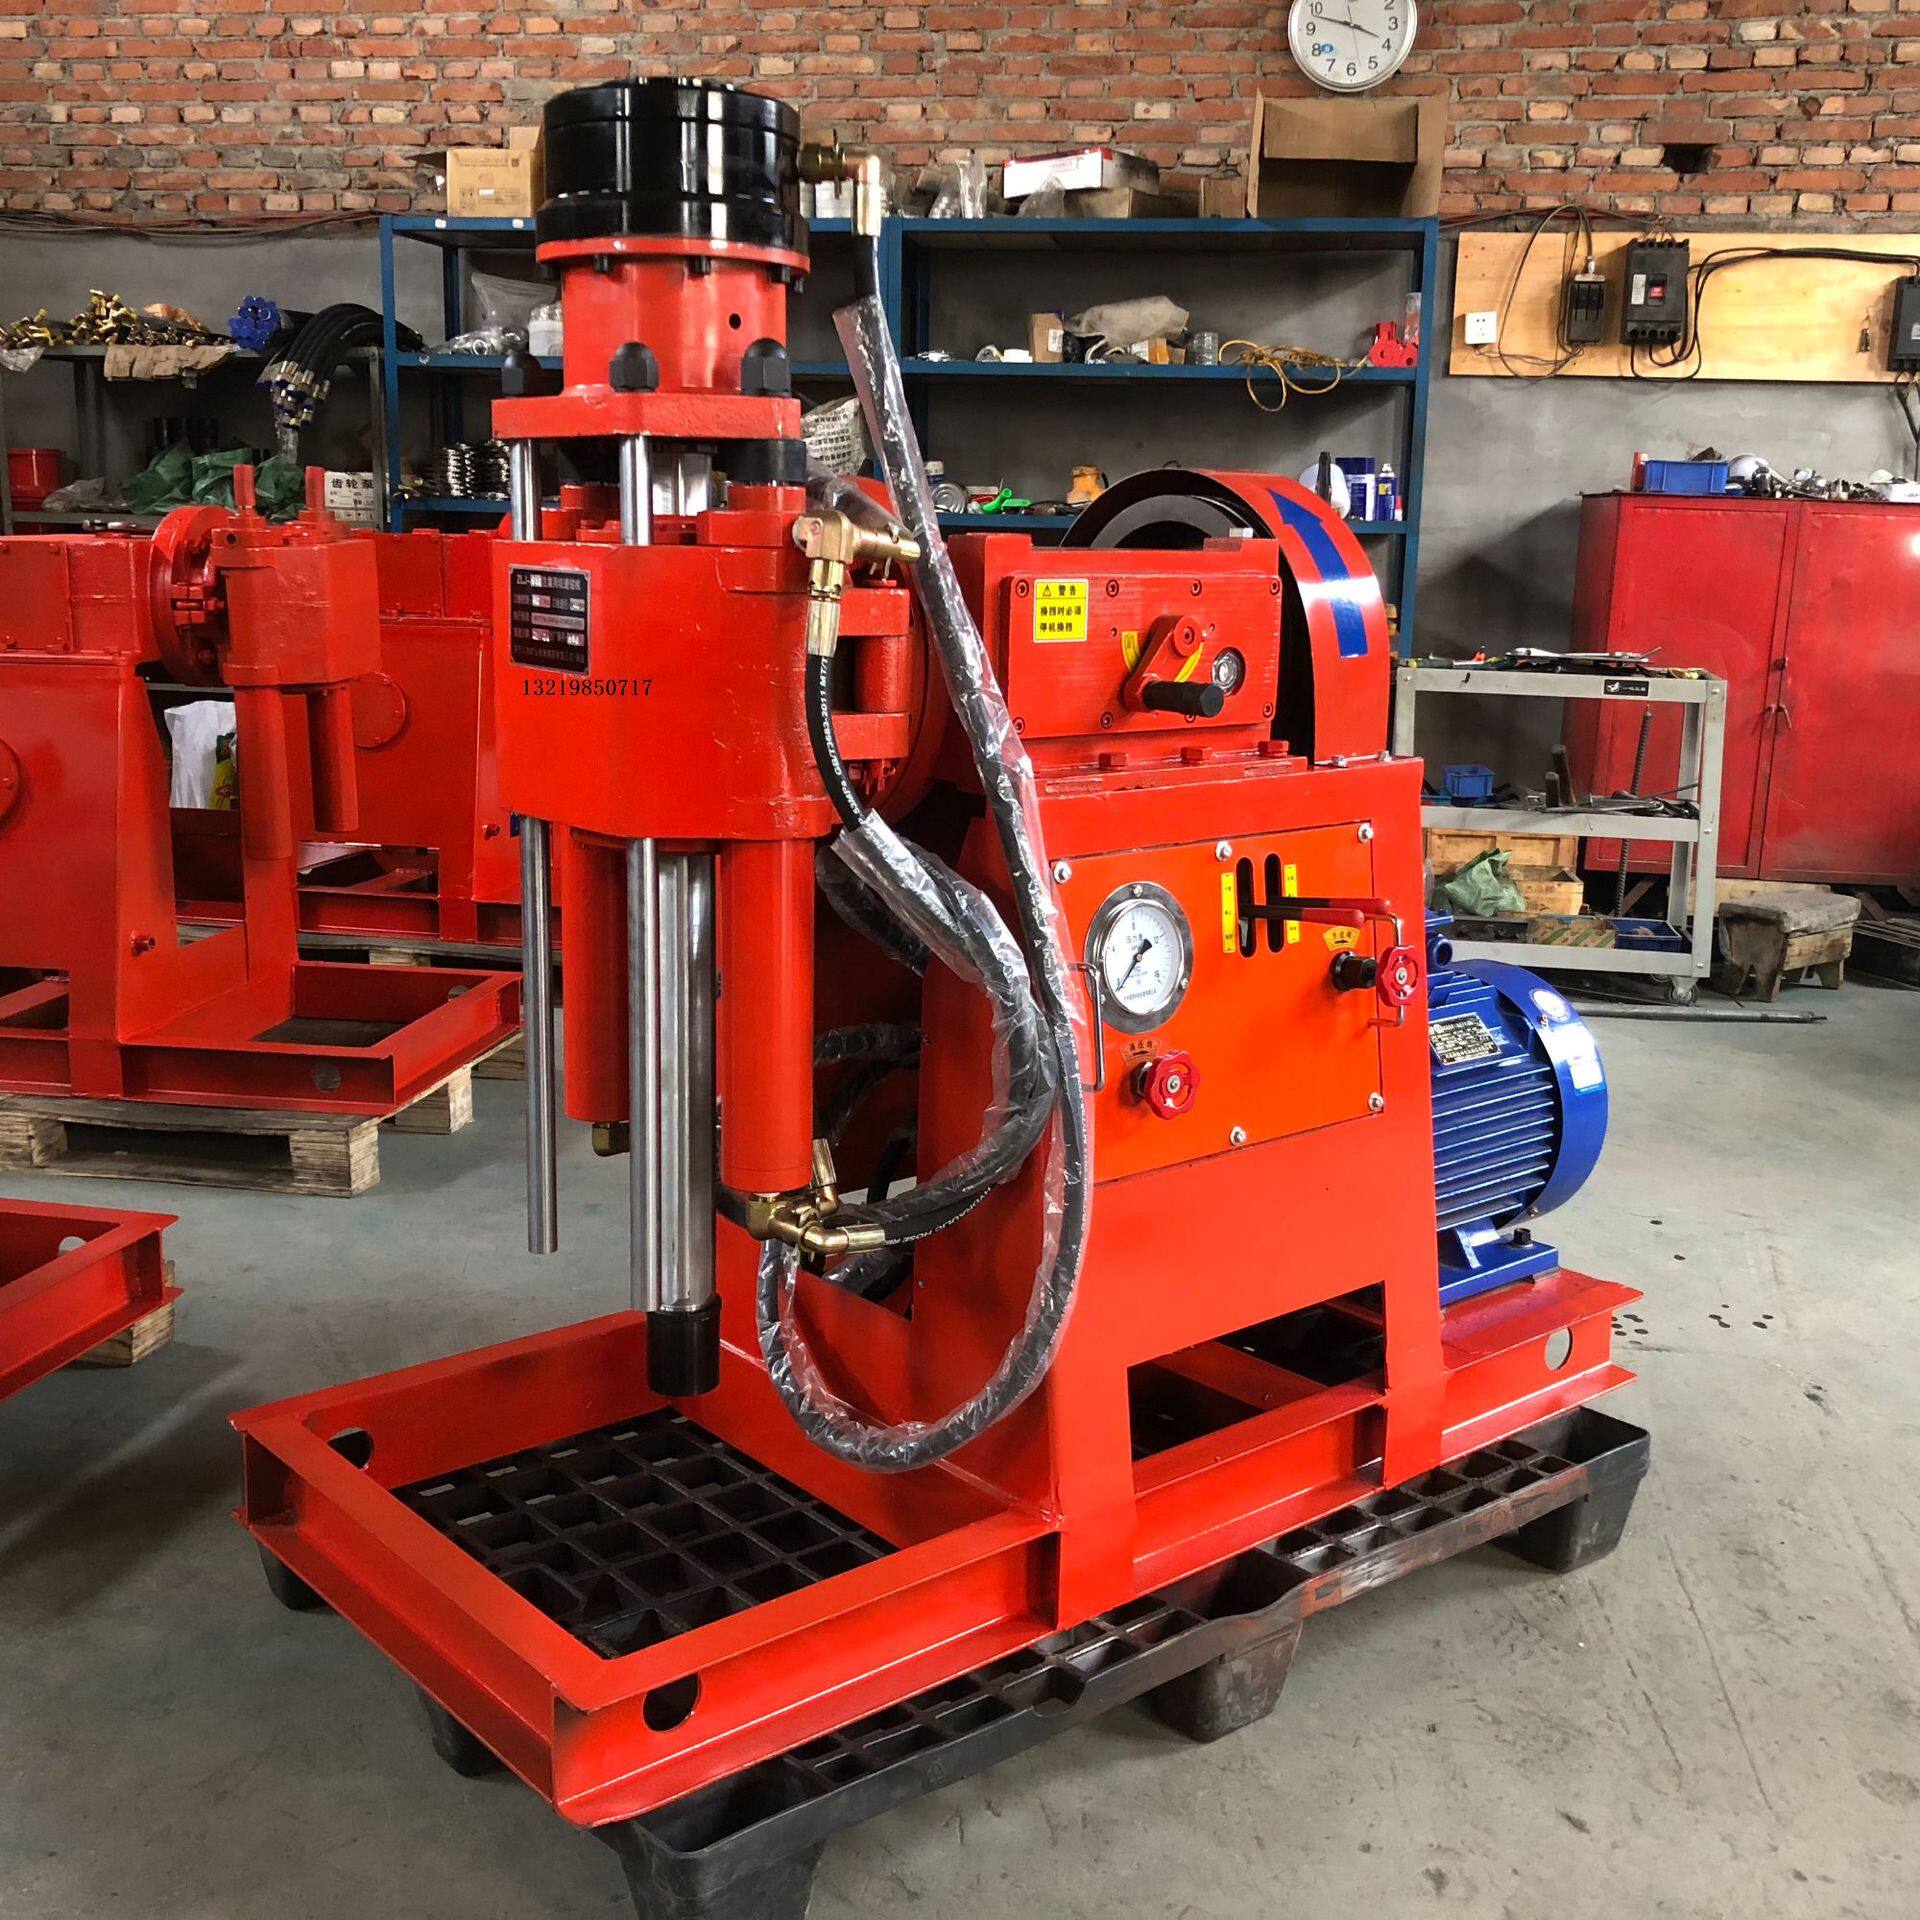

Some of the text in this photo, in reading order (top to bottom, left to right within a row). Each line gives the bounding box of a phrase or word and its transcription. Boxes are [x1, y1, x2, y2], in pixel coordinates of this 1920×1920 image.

[1309, 1, 1323, 15] 10
[1306, 22, 1316, 36] 9
[1388, 16, 1399, 31] 3
[1311, 43, 1322, 57] 8
[1381, 38, 1392, 52] 4
[1326, 58, 1336, 72] 7
[1346, 62, 1357, 77] 6
[1367, 56, 1378, 70] 5
[1058, 584, 1076, 597] 警告
